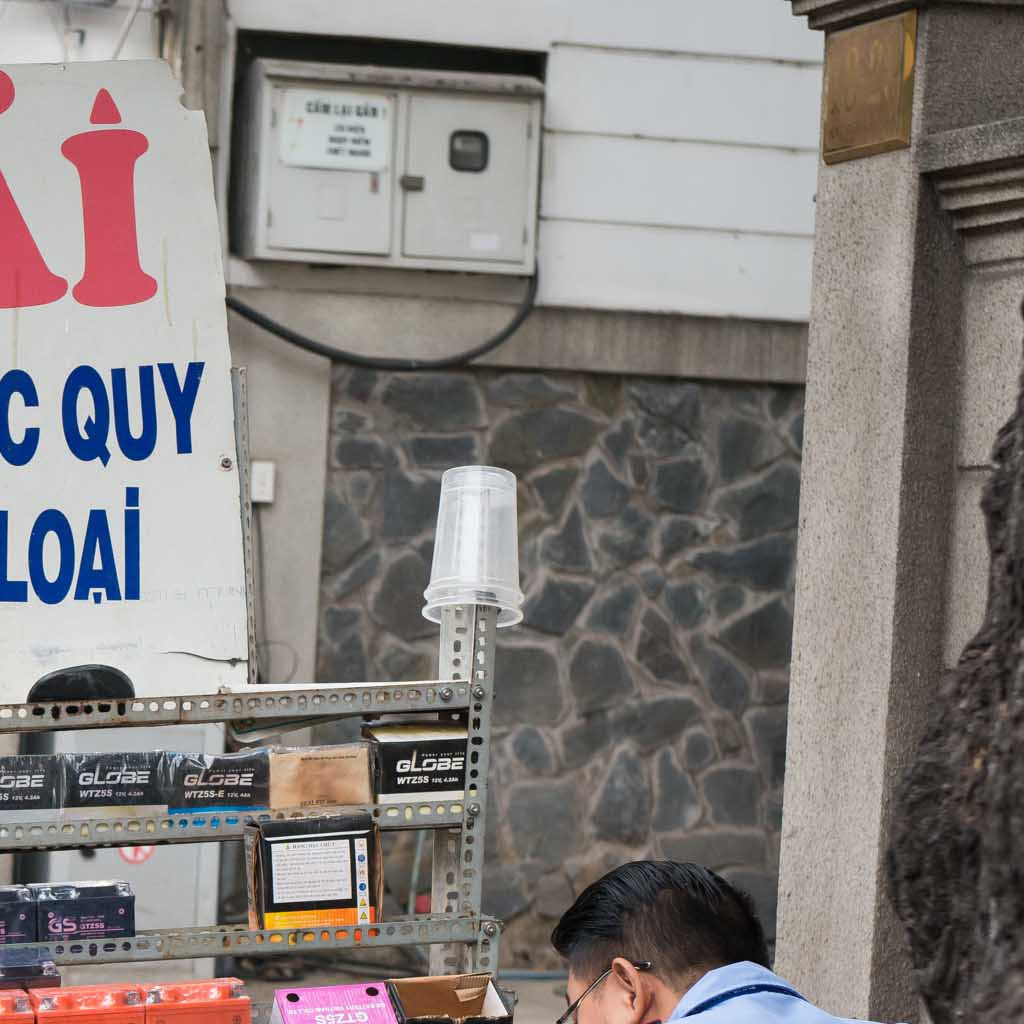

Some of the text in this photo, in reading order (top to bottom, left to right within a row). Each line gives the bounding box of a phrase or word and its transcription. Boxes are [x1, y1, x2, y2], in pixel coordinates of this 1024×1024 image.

[61, 361, 205, 468] QUY
[396, 750, 465, 773] GLOBE
[78, 763, 151, 785] GLOBE
[183, 767, 254, 786] GLOBE
[397, 776, 430, 785] WTZ5S
[79, 789, 113, 798] WTZ5S
[184, 789, 225, 799] WTZ5S-E
[48, 918, 77, 933] GS
